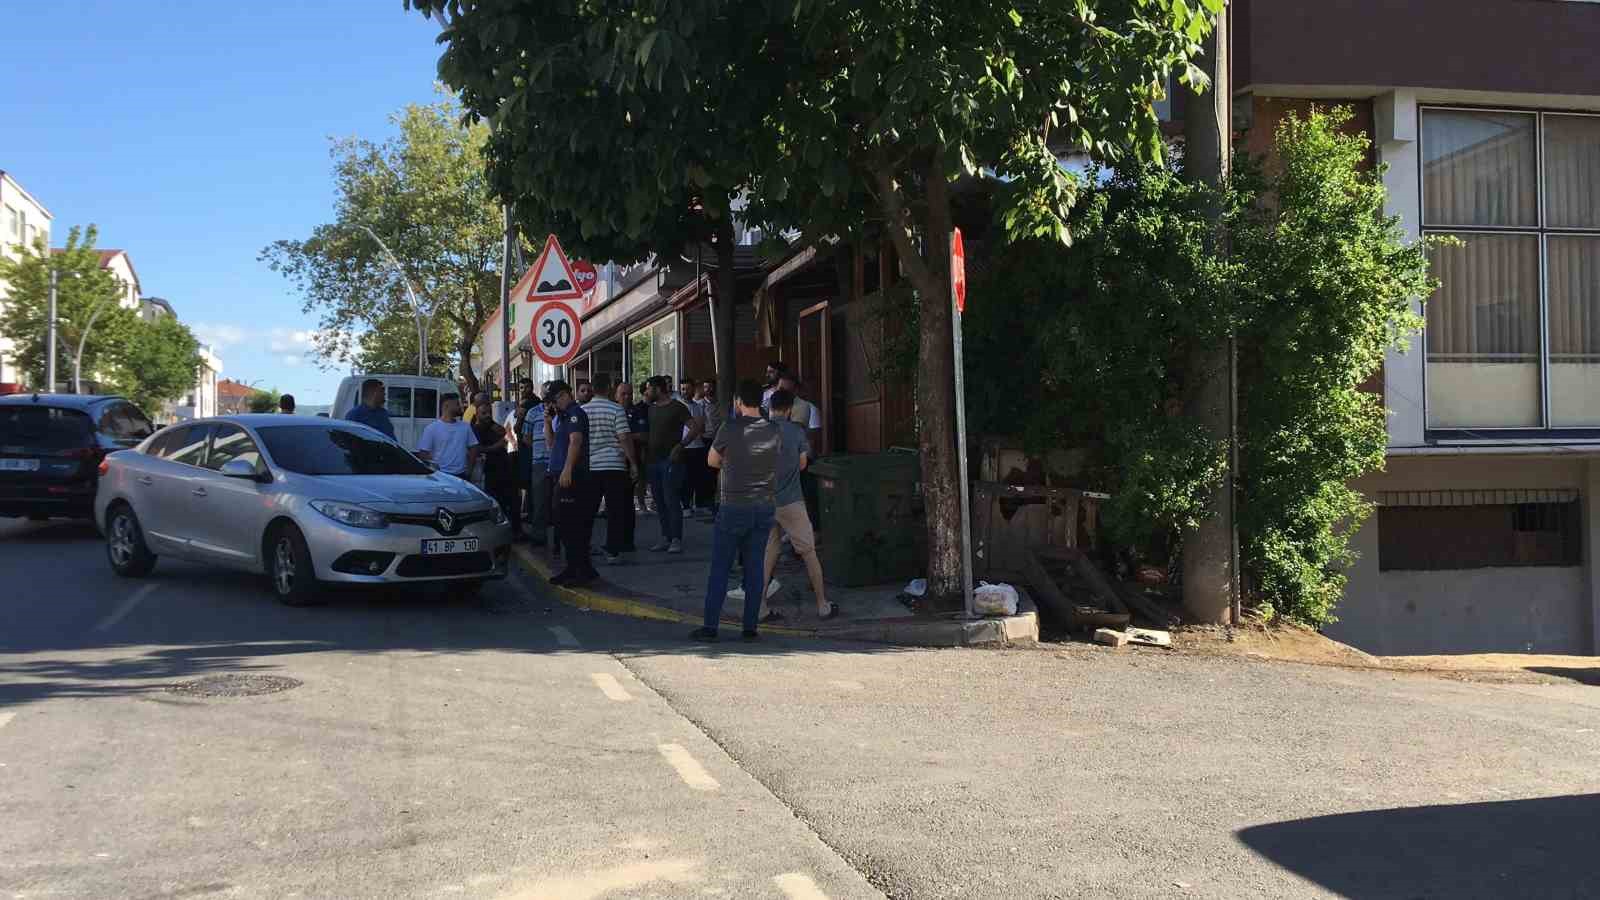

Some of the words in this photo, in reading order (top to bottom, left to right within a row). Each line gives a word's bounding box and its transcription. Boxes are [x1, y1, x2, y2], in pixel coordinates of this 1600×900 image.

[542, 318, 571, 347] 30
[428, 541, 438, 553] 41
[444, 541, 455, 553] BP
[464, 540, 477, 552] 130
